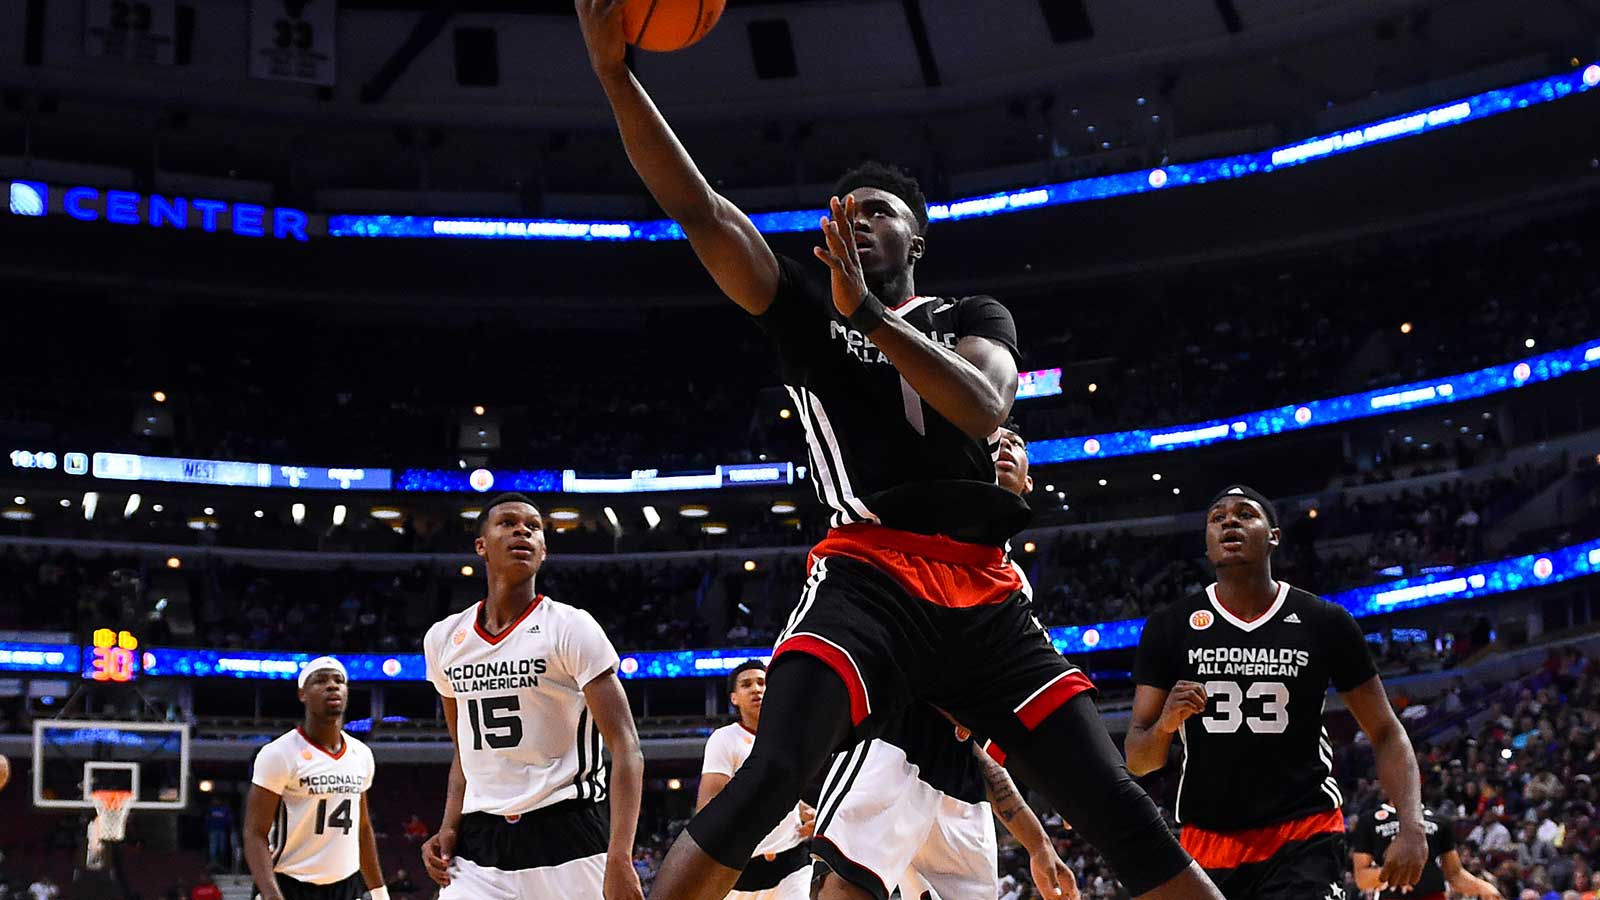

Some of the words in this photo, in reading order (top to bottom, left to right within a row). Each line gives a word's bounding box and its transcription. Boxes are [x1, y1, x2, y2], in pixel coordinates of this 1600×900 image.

[64, 187, 309, 241] CENTER
[452, 681, 469, 692] ALL
[471, 675, 539, 692] AMERICAN
[1197, 662, 1222, 675] ALL
[1224, 663, 1299, 677] AMERICAN
[467, 694, 523, 750] 15
[1202, 681, 1290, 733] 33
[308, 786, 324, 795] ALL
[326, 785, 360, 795] AMERICA
[314, 798, 353, 835] 14
